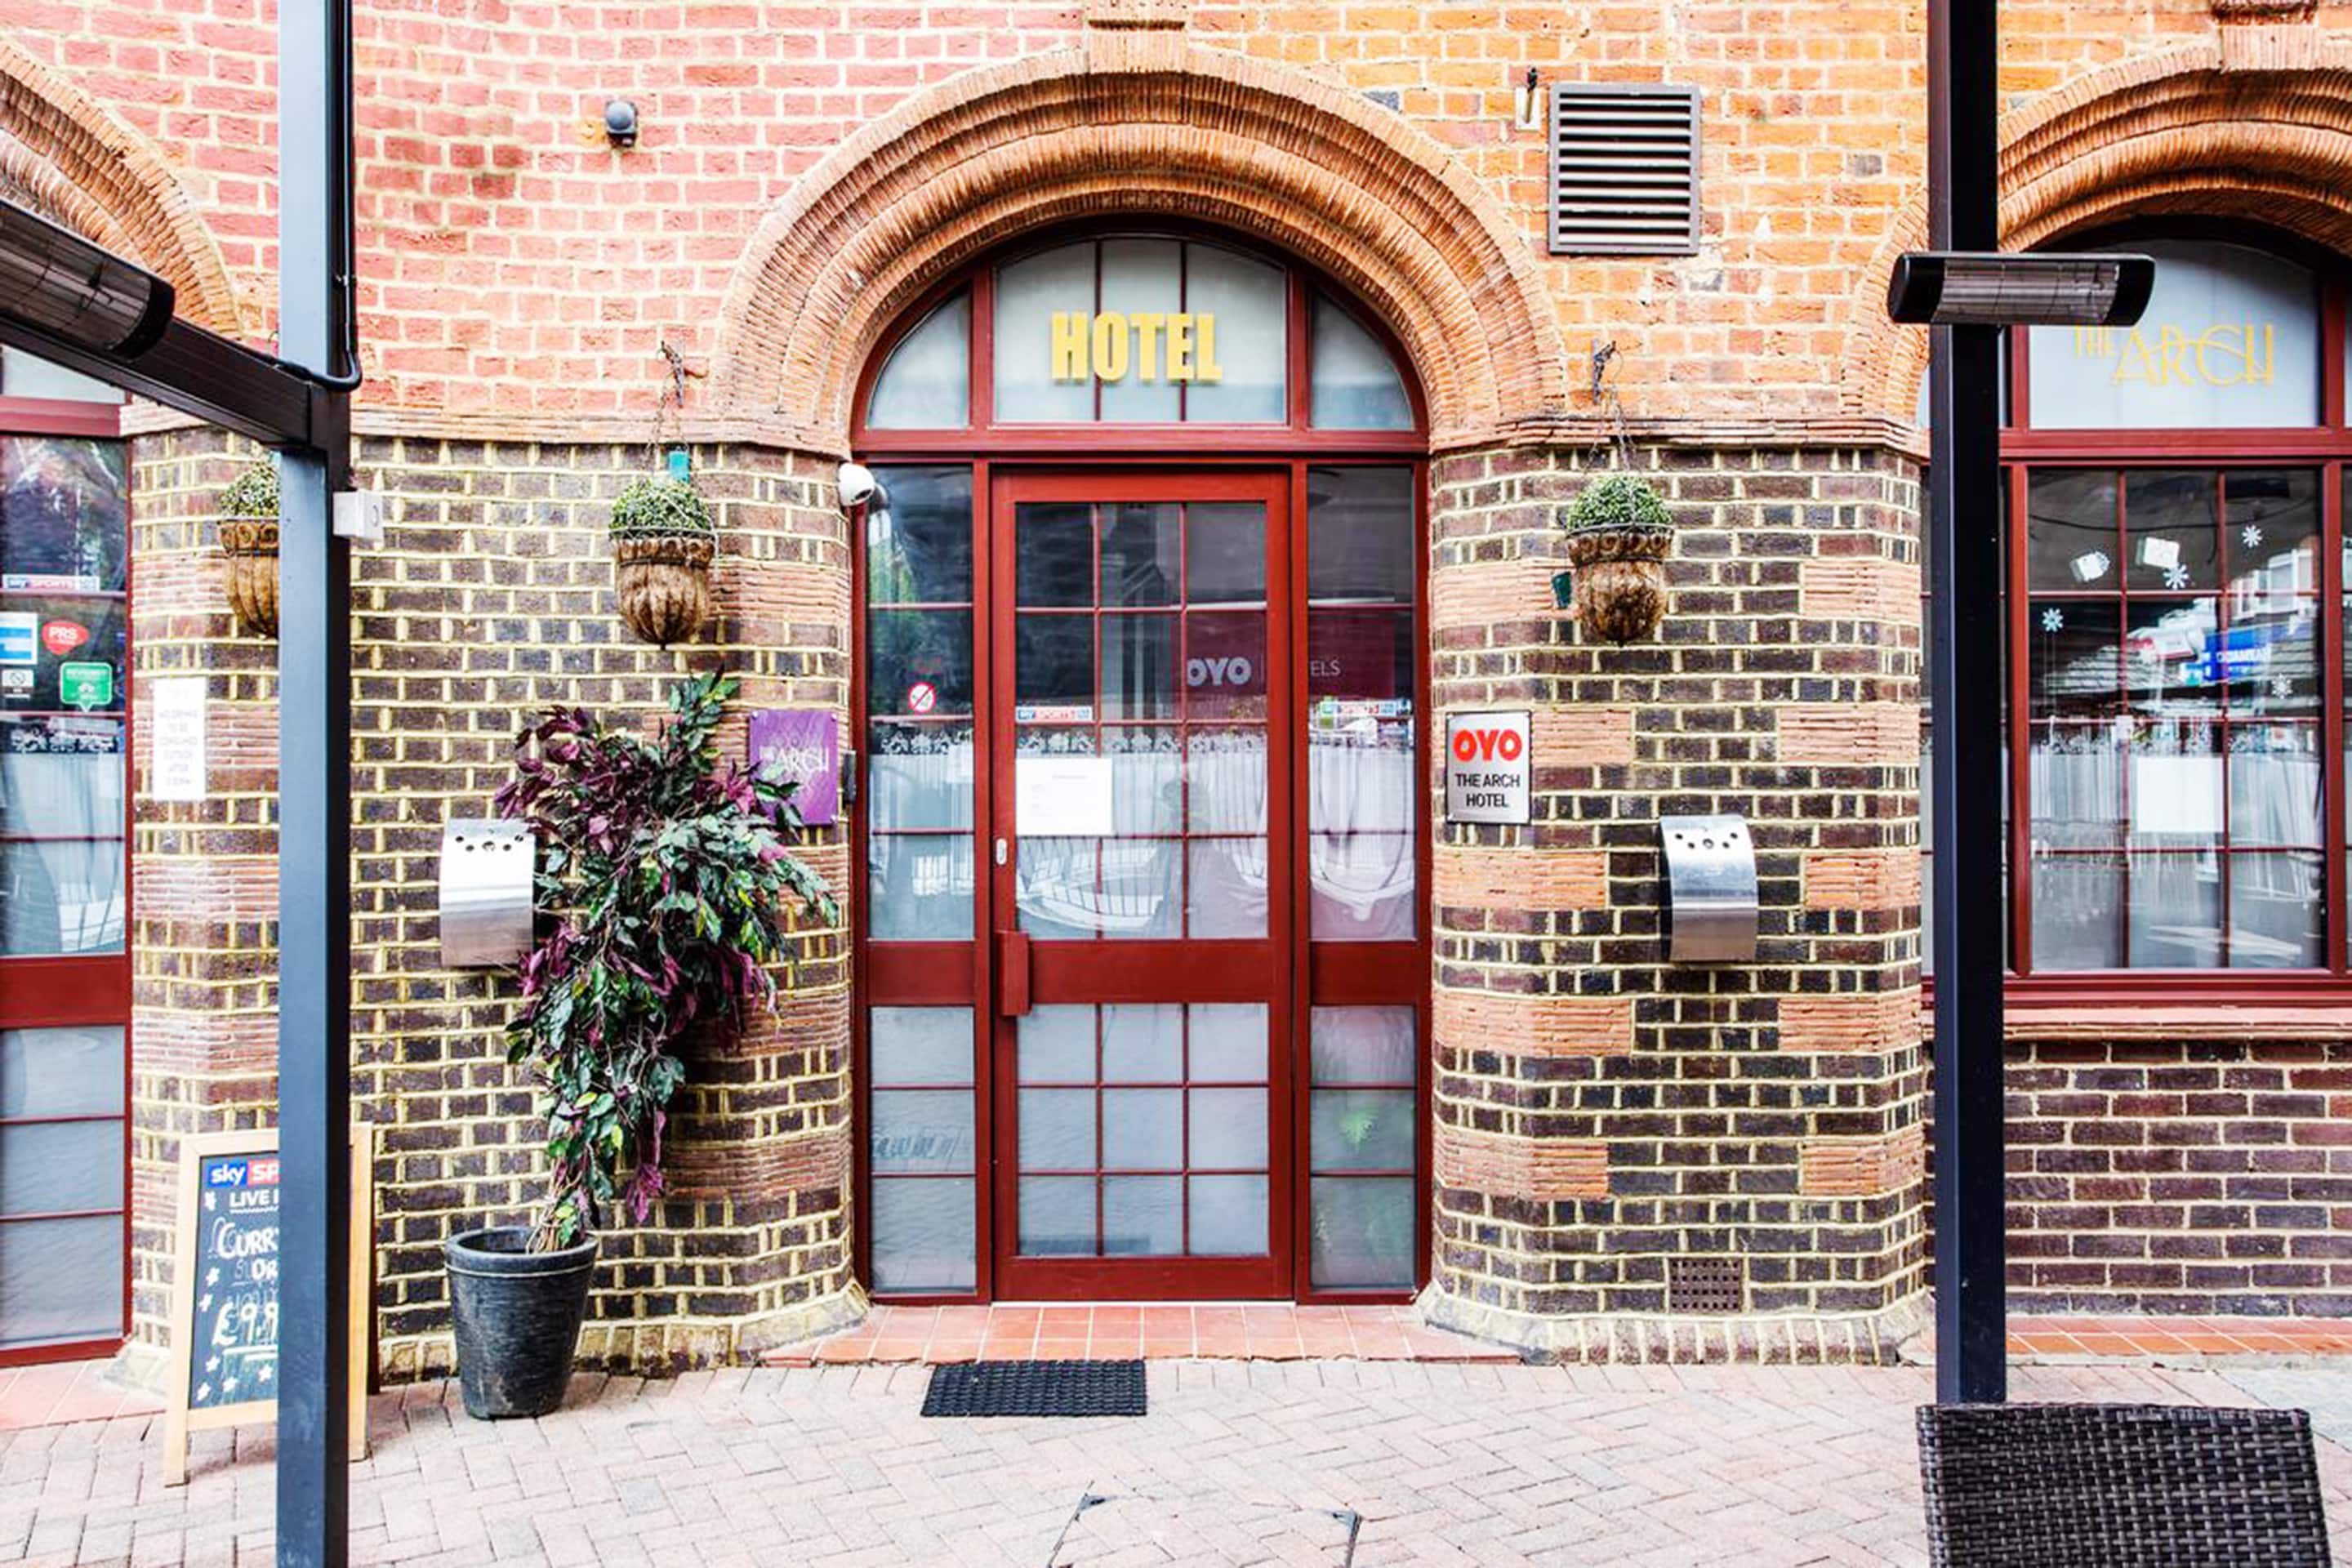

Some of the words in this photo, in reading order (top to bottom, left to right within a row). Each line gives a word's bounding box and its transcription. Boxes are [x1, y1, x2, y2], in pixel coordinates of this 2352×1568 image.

[1050, 311, 1223, 384] HOTEL
[2110, 323, 2274, 387] ARCH
[1187, 657, 1252, 687] OYO
[1310, 660, 1342, 677] ELS
[1453, 729, 1522, 762] OYO
[1454, 773, 1481, 787] THE
[1483, 773, 1521, 787] ARCH
[1466, 793, 1509, 808] HOTEL
[211, 1163, 246, 1186] sky
[229, 1190, 270, 1208] LIVE
[217, 1223, 279, 1259] CURR
